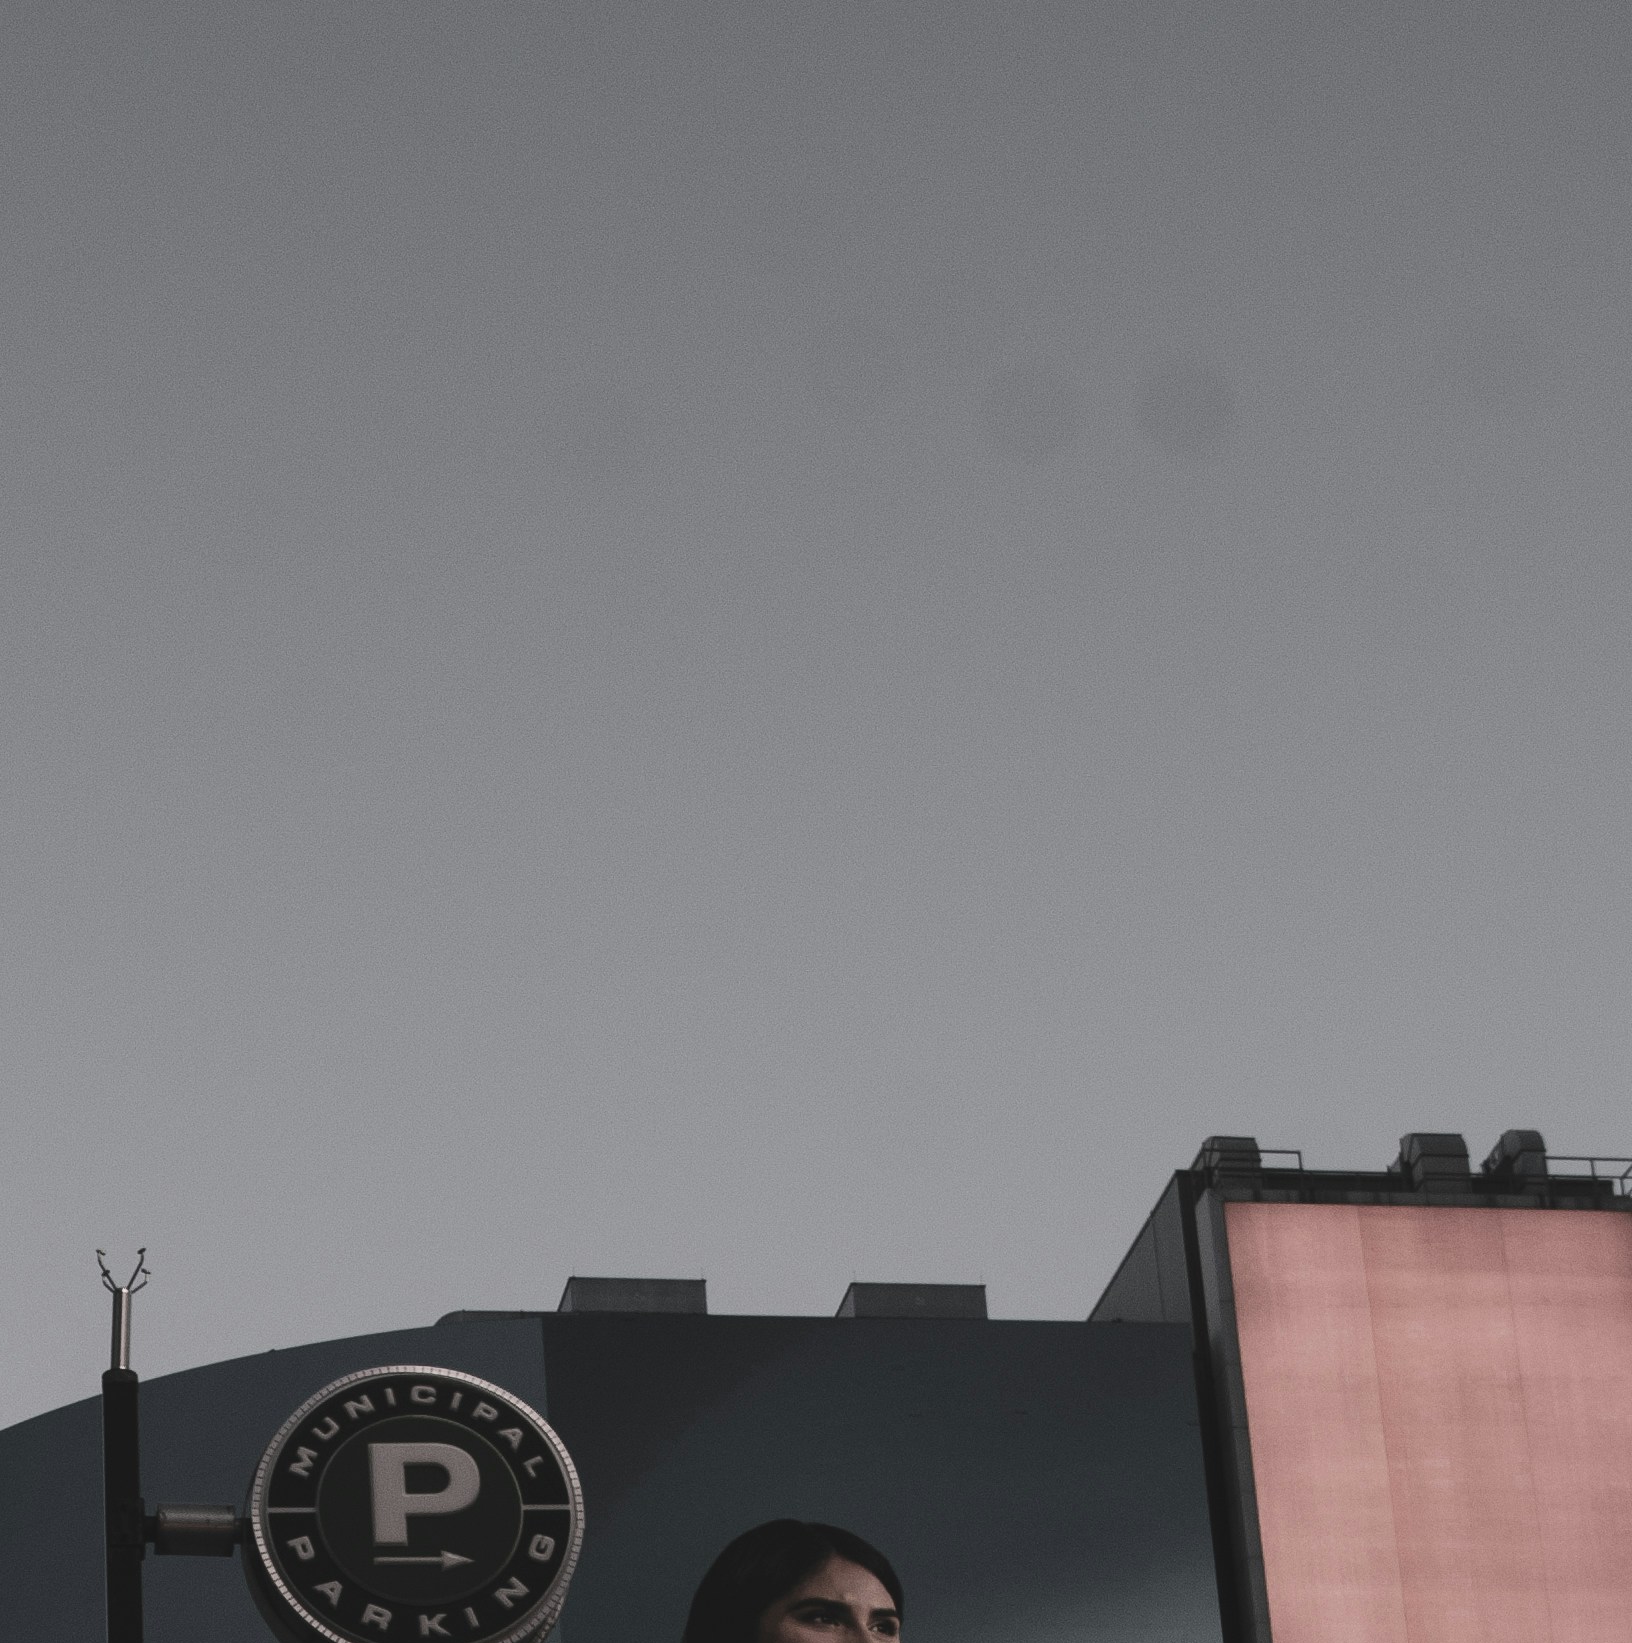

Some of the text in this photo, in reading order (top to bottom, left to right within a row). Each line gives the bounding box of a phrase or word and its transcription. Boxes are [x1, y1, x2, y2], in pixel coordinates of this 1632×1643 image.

[288, 1384, 544, 1478] MUNICIPAL
[369, 1442, 481, 1546] P
[286, 1533, 556, 1637] PARKING
